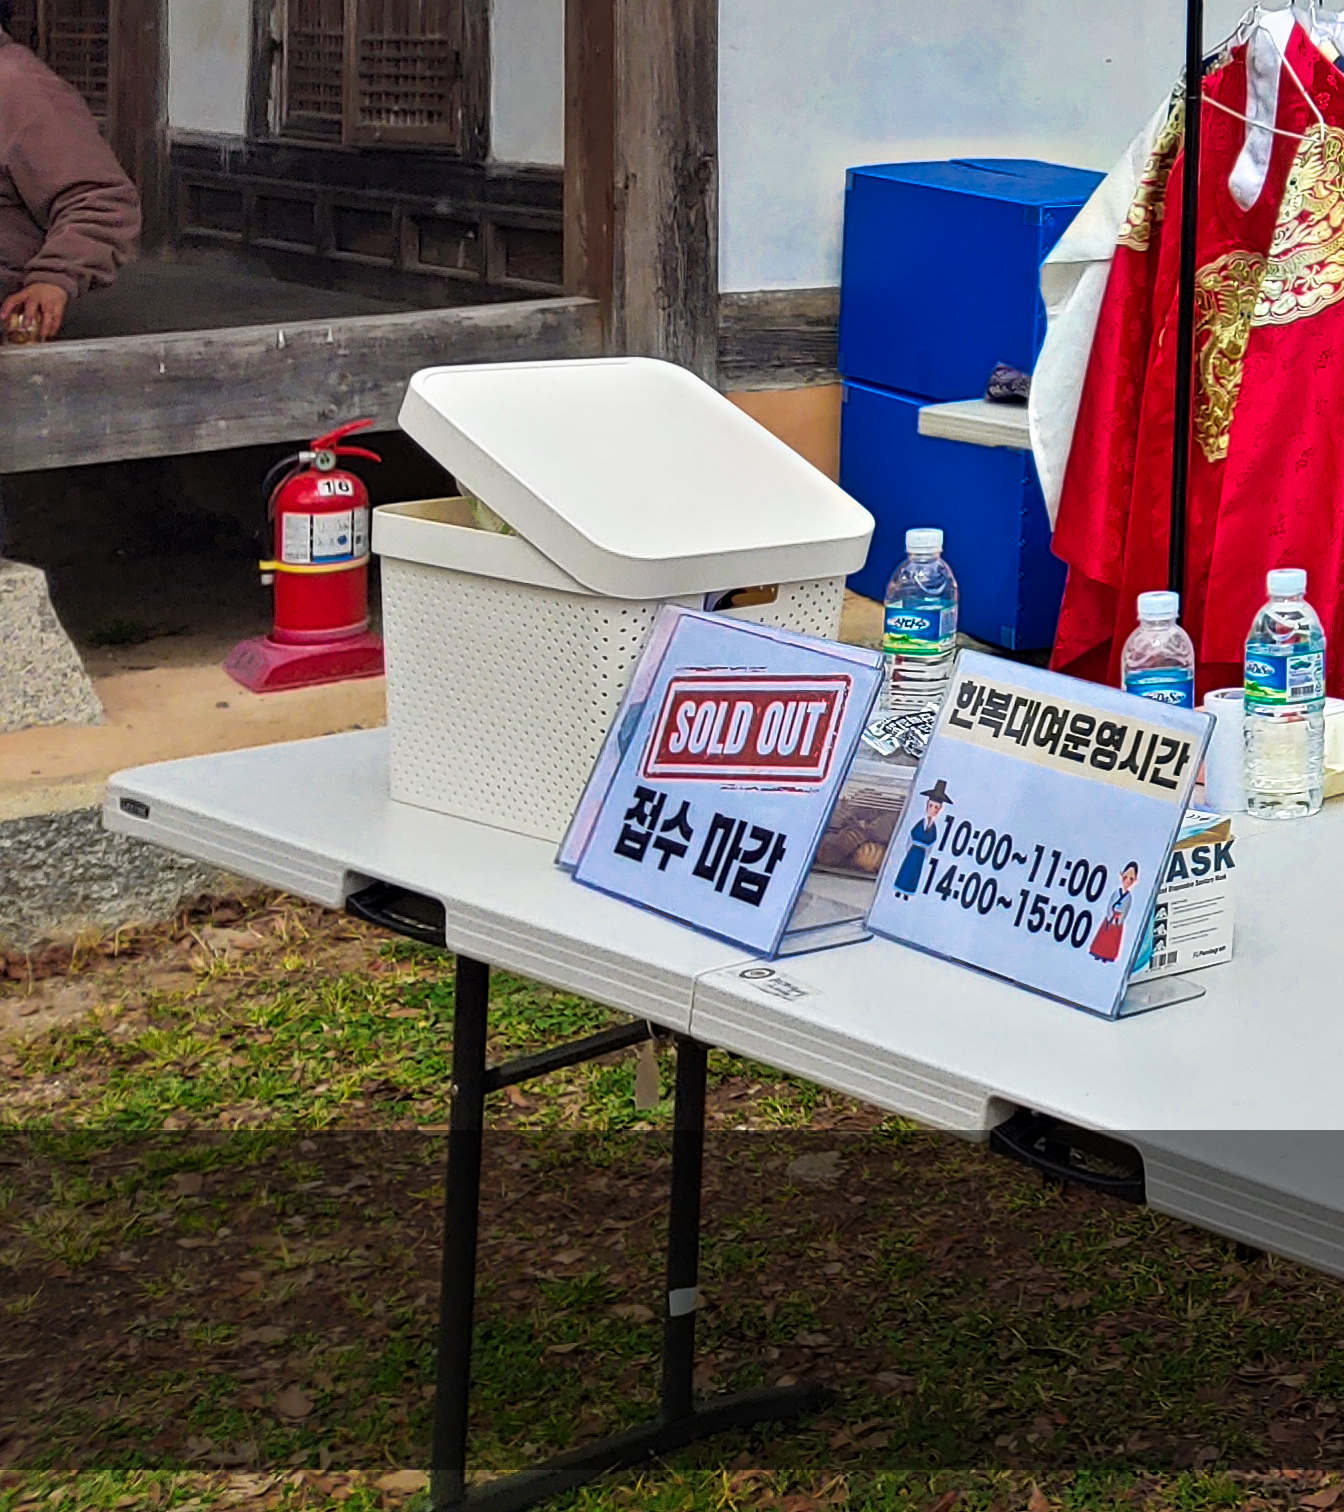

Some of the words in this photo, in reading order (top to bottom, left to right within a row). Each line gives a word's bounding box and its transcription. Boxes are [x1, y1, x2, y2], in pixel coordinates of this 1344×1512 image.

[668, 700, 754, 756] SOLD
[756, 700, 827, 756] OUT
[613, 784, 694, 872] 접수
[692, 812, 787, 907] 마감
[938, 815, 1108, 903] 10:00~11:00
[1166, 838, 1236, 882] ASK
[922, 857, 1093, 948] 14:00~15:00
